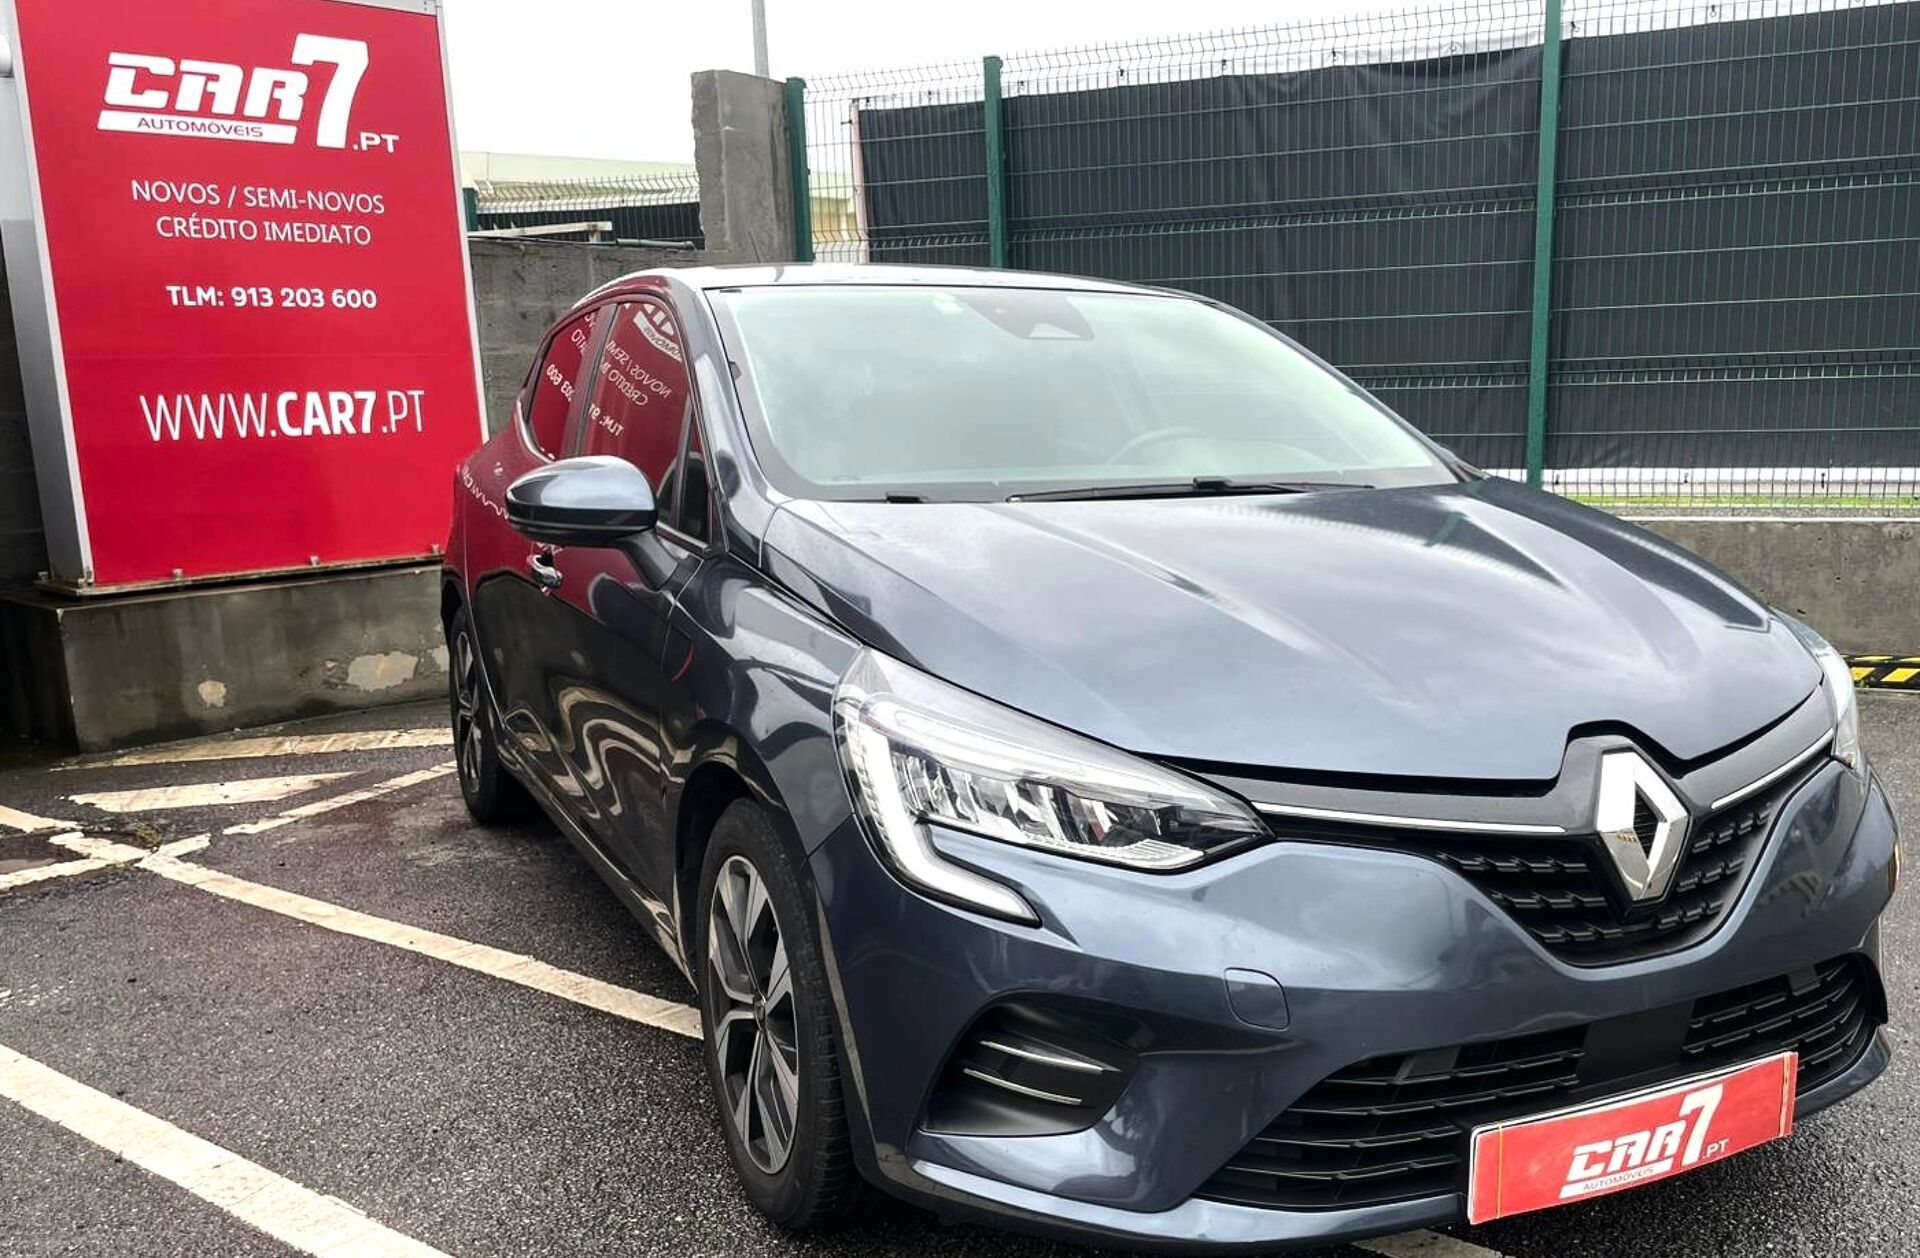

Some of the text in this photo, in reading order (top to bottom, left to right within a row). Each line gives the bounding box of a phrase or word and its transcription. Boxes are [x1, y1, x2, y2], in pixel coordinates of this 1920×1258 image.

[131, 179, 385, 215] NOVOS / SEMI-NOVOS
[156, 212, 371, 245] CRÉDITO IMEDIATO
[165, 285, 377, 309] TLM: 913 203 600
[139, 389, 425, 442] WWW.CAR7.PT
